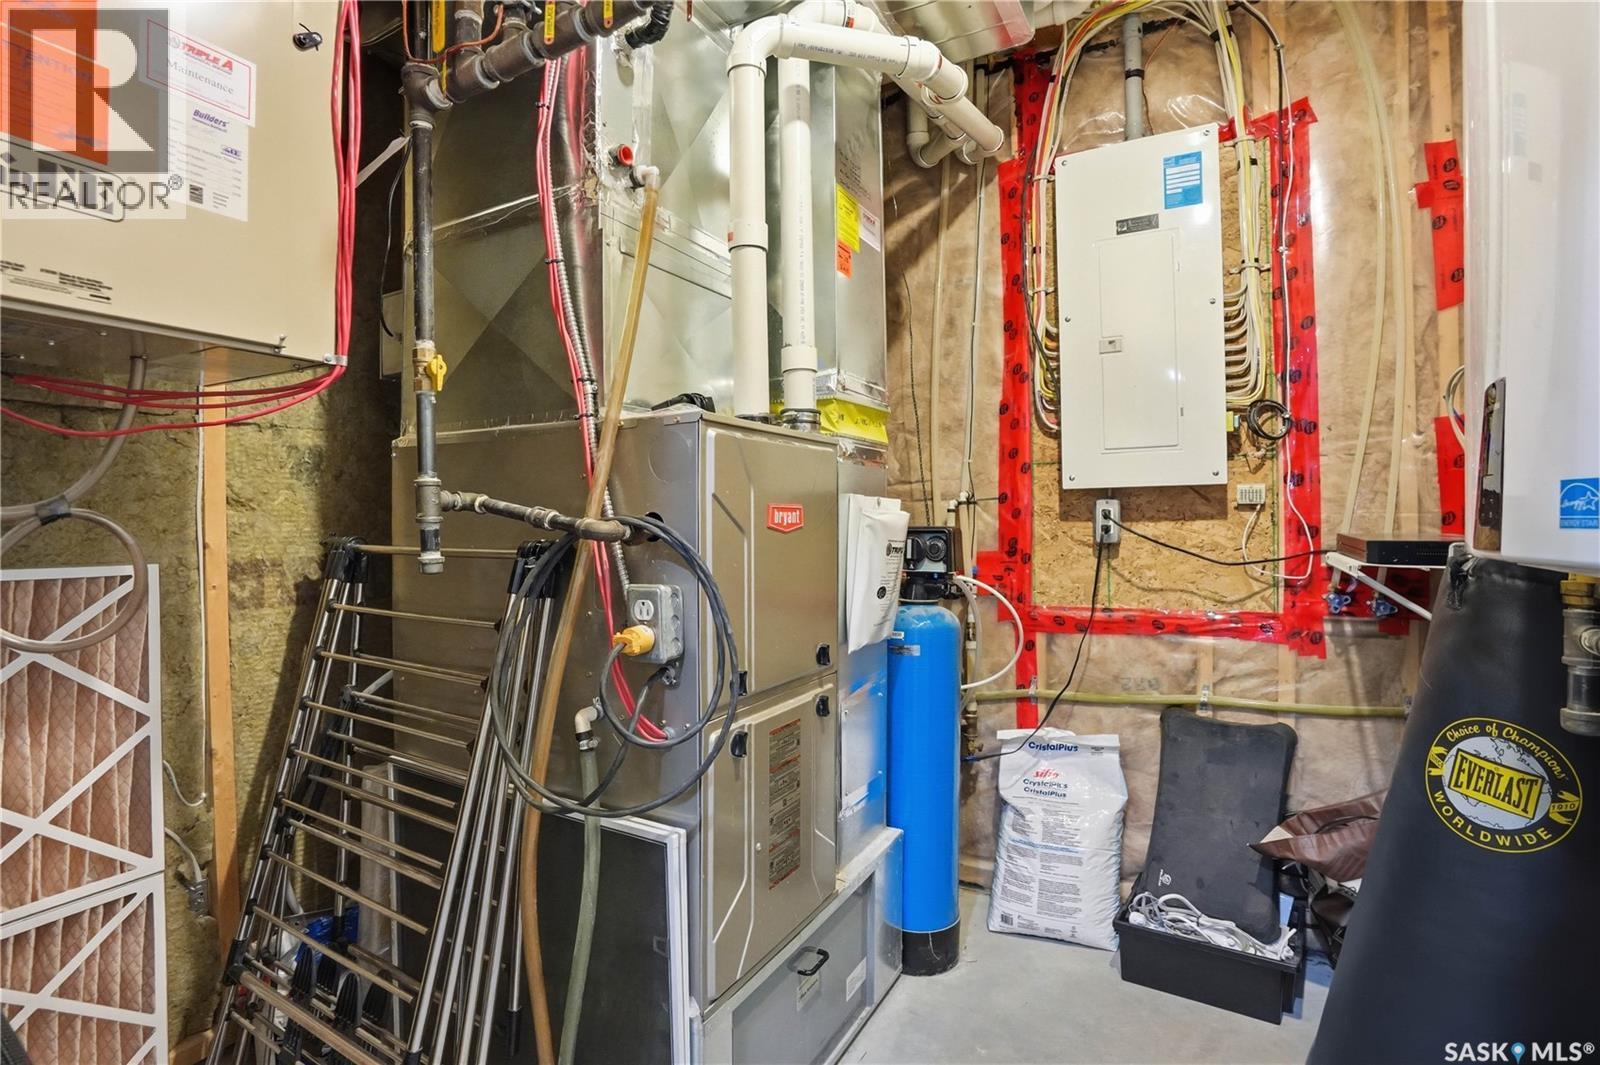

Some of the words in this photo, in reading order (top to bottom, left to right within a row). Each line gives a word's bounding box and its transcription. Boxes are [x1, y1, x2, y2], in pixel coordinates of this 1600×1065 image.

[167, 57, 234, 95] Maintenance
[774, 508, 800, 526] bryant
[1028, 741, 1079, 753] CristalPlus
[1446, 724, 1481, 743] Choice
[1485, 722, 1499, 738] of
[1502, 726, 1567, 780] Champions
[1453, 754, 1538, 815] EVERLAST
[1434, 791, 1553, 847] WORLDWIDE
[1551, 802, 1577, 811] 1910
